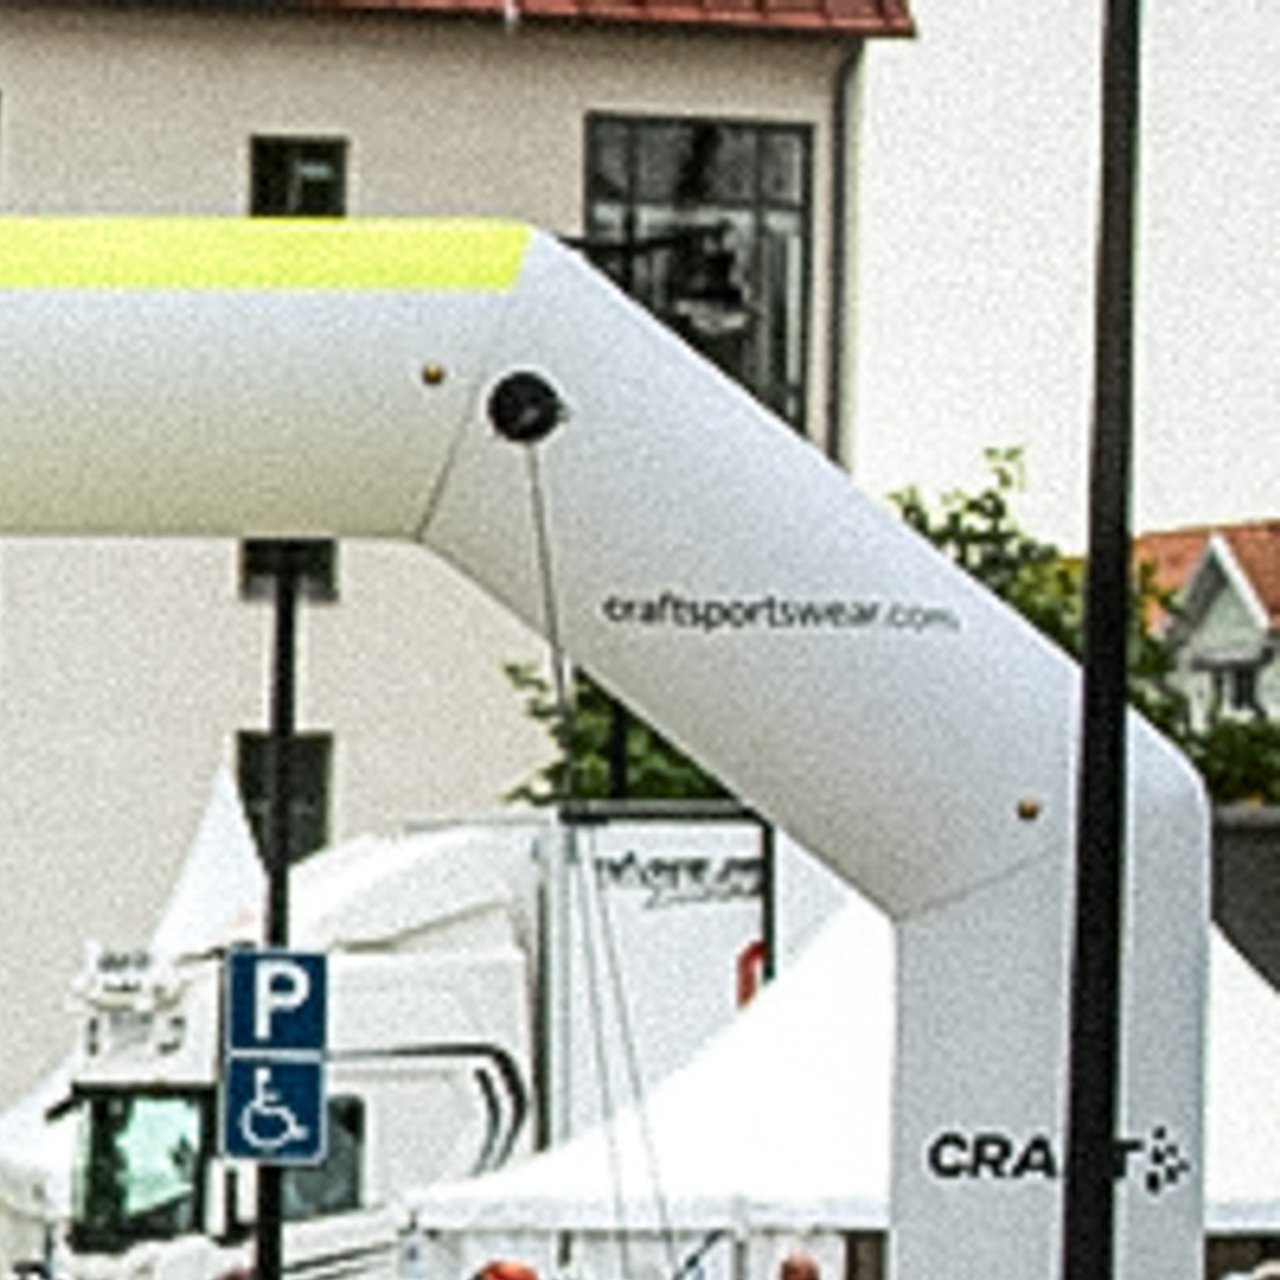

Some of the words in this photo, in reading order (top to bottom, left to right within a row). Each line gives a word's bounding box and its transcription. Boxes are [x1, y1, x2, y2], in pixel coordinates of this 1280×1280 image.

[601, 593, 961, 632] craftsportswear.com
[253, 960, 311, 1040] P
[927, 1132, 1145, 1178] CRAT
